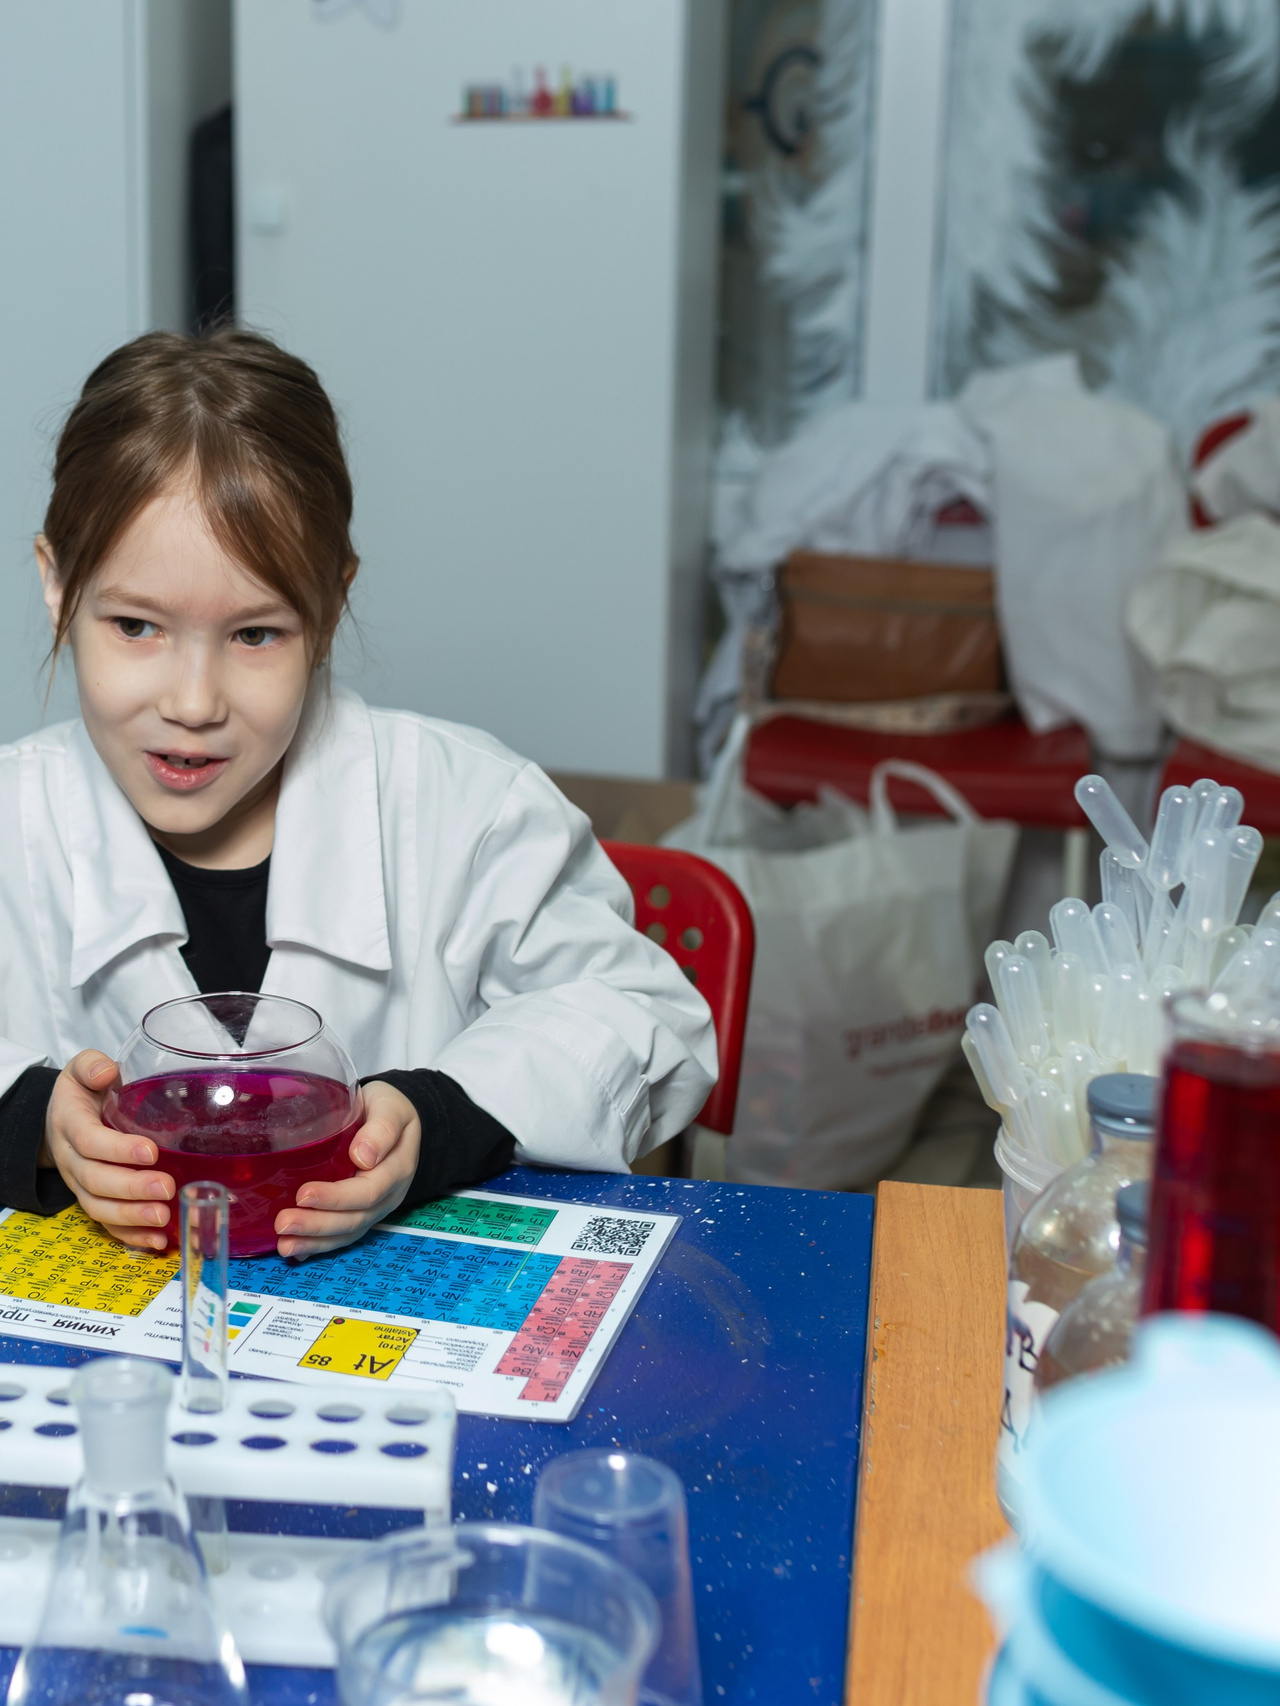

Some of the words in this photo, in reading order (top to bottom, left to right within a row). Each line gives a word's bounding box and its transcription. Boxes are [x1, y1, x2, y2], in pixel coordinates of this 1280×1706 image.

[496, 1213, 513, 1221] Pa
[414, 1220, 434, 1229] Pm
[13, 1225, 31, 1233] Xe
[78, 1237, 92, 1245] Te
[400, 1245, 418, 1253] Bh
[432, 1249, 451, 1258] Sg
[59, 1254, 77, 1262] Se
[353, 1258, 371, 1266] Os
[466, 1255, 486, 1263] Db
[91, 1259, 110, 1267] As
[238, 1259, 257, 1270] Ag
[386, 1263, 405, 1271] Re
[504, 1260, 520, 1268] Rf
[11, 1266, 26, 1274] Cl
[122, 1264, 141, 1272] Ge
[271, 1266, 290, 1275] Pd
[155, 1269, 175, 1277] Ga
[304, 1271, 323, 1279] Rh
[570, 1268, 589, 1277] Ra
[338, 1276, 358, 1284] Ru
[457, 1273, 471, 1281] Ta
[375, 1282, 390, 1290] Tc
[491, 1279, 508, 1287] Hf
[527, 1283, 543, 1291] La
[261, 1285, 275, 1293] Ni
[405, 1286, 426, 1295] Mo
[560, 1287, 578, 1296] Ba
[289, 1289, 309, 1298] Co
[441, 1292, 461, 1300] Nb
[596, 1291, 614, 1299] Cs
[326, 1295, 343, 1303] Fe
[357, 1300, 378, 1309] Mn
[130, 1307, 141, 1315] B
[395, 1306, 412, 1315] Cr
[551, 1306, 567, 1315] Sr
[584, 1310, 603, 1318] Rb
[470, 1317, 481, 1325] Ti
[501, 1321, 519, 1329] Sc
[374, 1326, 415, 1337] Astatine
[536, 1326, 556, 1334] Ca
[377, 1334, 411, 1343] Астат
[378, 1341, 406, 1351] [210]
[522, 1344, 544, 1355] Mg
[561, 1350, 580, 1358] Na
[306, 1354, 332, 1366] 85
[353, 1354, 395, 1374] At
[512, 1367, 532, 1375] Be
[557, 1371, 569, 1379] Li
[544, 1392, 557, 1400] H
